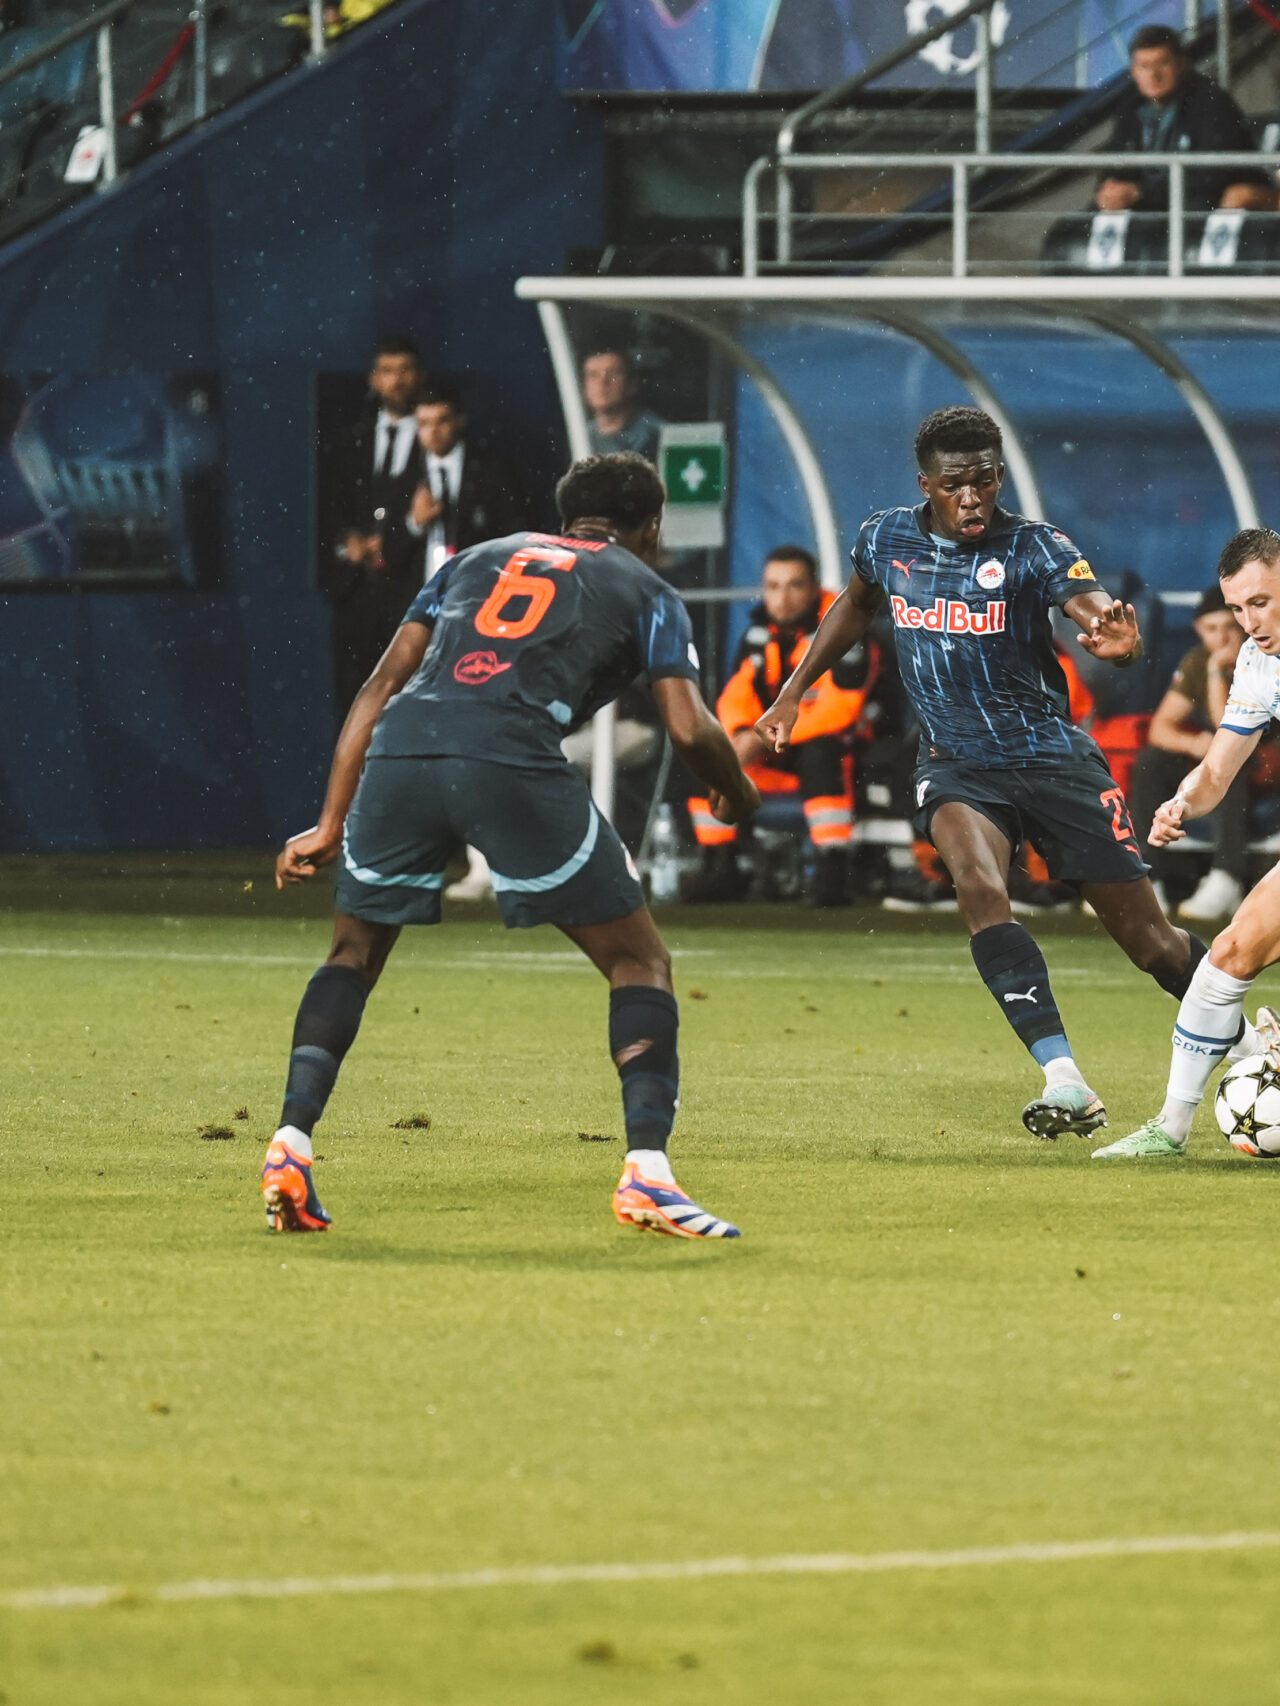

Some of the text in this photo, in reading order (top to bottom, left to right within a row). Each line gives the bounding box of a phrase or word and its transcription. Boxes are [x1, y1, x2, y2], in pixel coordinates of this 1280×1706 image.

[474, 546, 577, 640] 6
[891, 596, 1005, 634] Red Bull
[1100, 787, 1136, 841] 2
